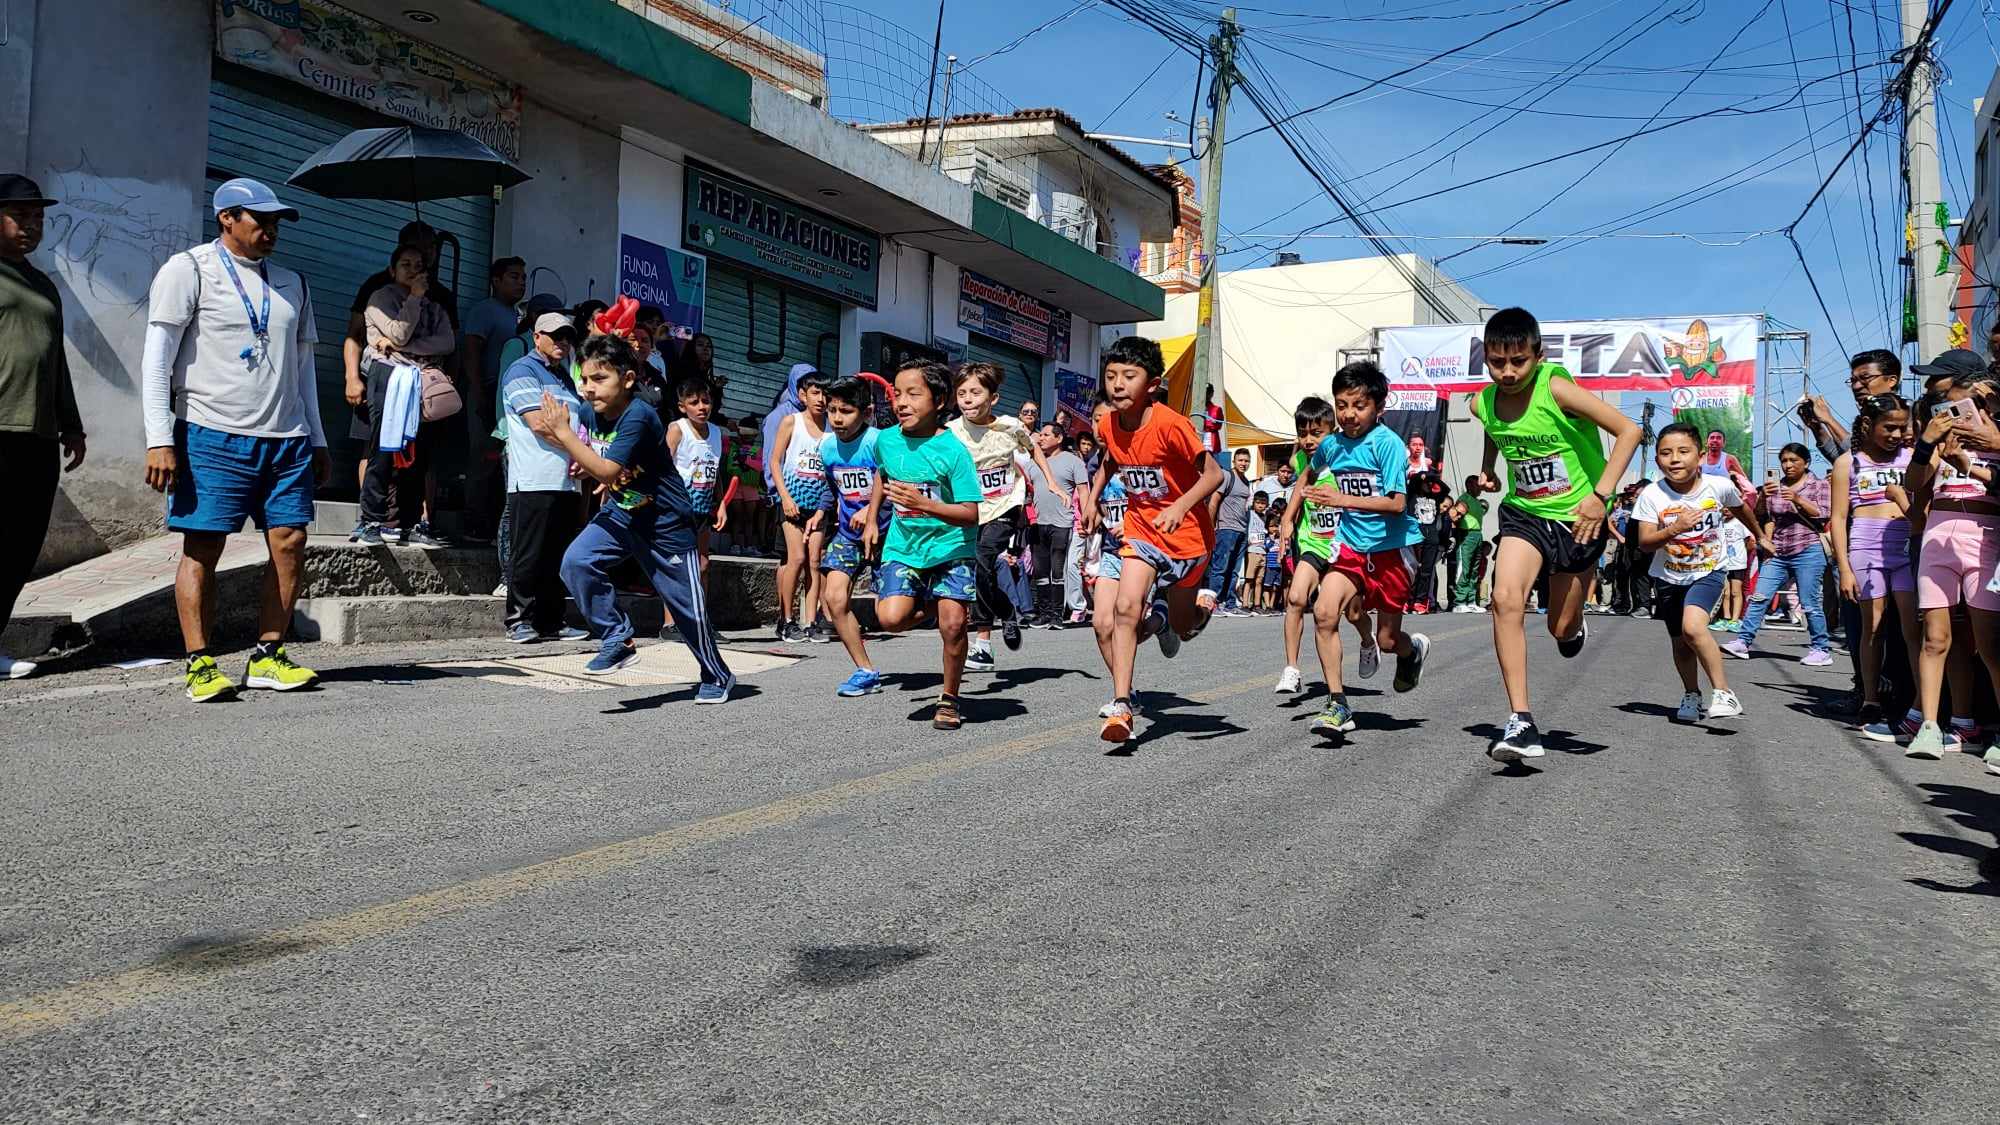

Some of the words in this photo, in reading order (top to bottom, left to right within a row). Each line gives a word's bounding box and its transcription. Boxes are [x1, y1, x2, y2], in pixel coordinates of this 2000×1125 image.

[298, 56, 377, 101] Cemitas
[385, 95, 444, 129] Sandwich
[698, 177, 871, 273] REPARACIONES
[623, 254, 659, 280] FUNDA
[622, 278, 671, 306] ORIGINAL
[962, 271, 1009, 309] Reparación
[1007, 290, 1019, 311] de
[1018, 294, 1051, 325] Celulares
[1424, 355, 1463, 367] SANCHEZ
[1425, 366, 1458, 378] ARENAS
[1399, 392, 1434, 402] SANCHEZ
[1399, 401, 1429, 411] ARENAS
[1696, 397, 1729, 408] ARENAS
[808, 458, 825, 472] 05
[1521, 461, 1554, 485] 107
[842, 472, 869, 489] 076
[981, 469, 1008, 488] 057
[1127, 470, 1160, 489] 073
[1341, 478, 1373, 497] 099
[1317, 511, 1343, 528] 087
